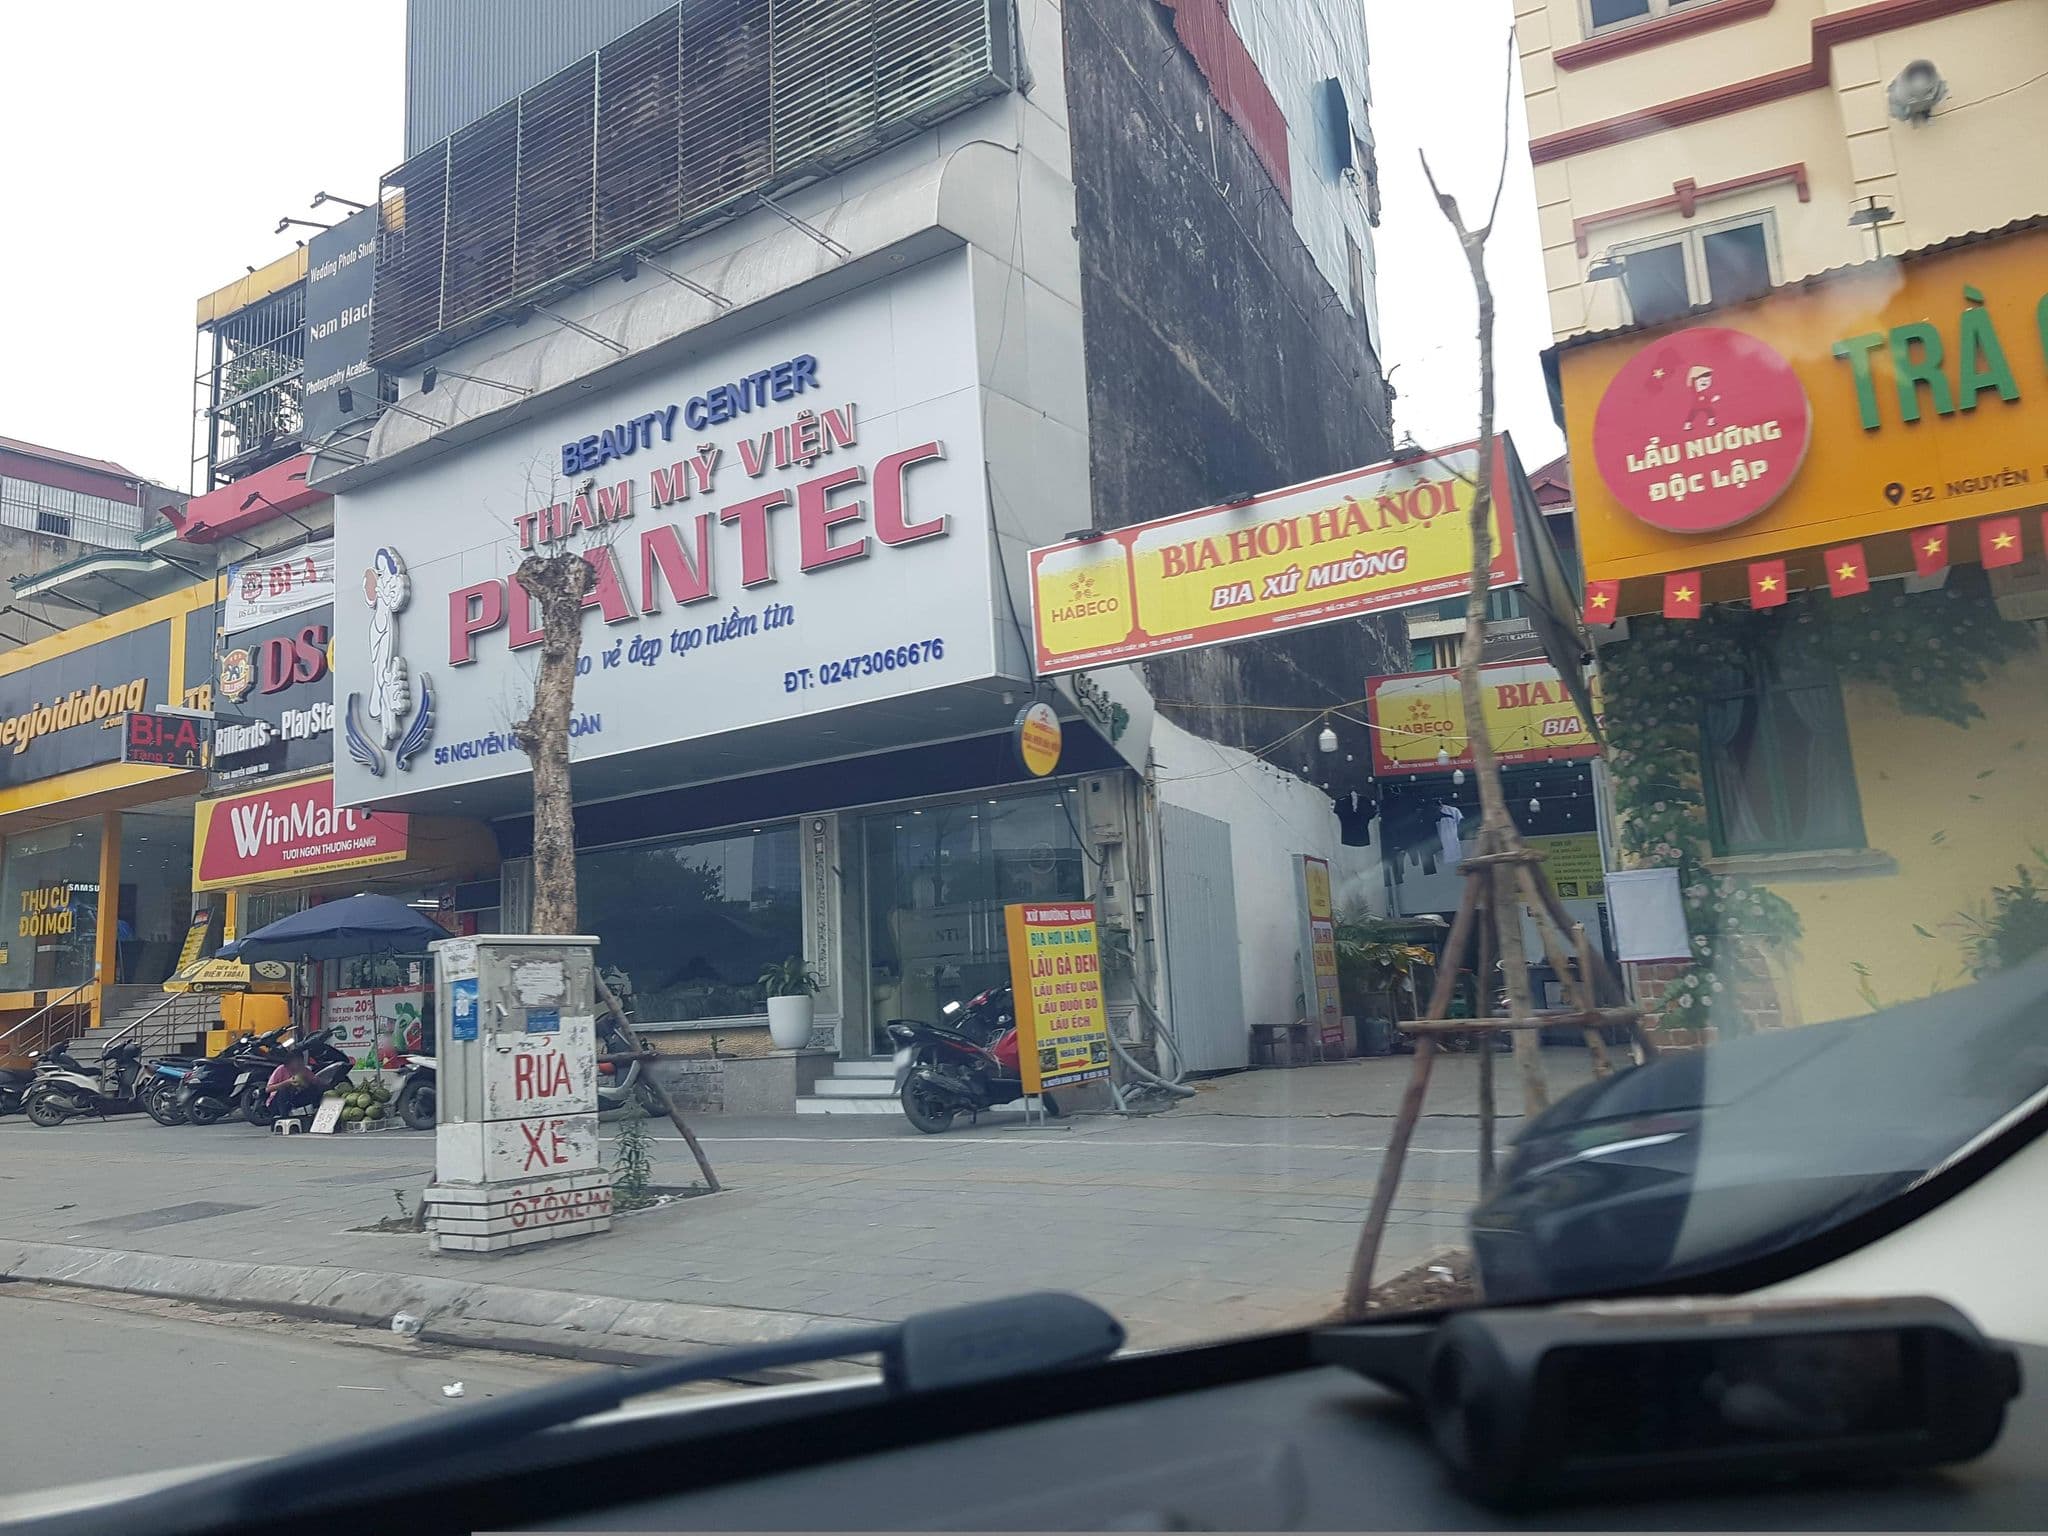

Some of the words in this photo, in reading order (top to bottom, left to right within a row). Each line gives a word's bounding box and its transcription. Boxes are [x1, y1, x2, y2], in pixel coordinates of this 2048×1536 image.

[311, 261, 337, 283] Wedding
[338, 250, 357, 271] Photo
[310, 318, 338, 343] Nam
[1832, 283, 2021, 431] TRÀ
[306, 367, 345, 396] Photography
[562, 405, 678, 477] BEAUTY
[684, 353, 821, 431] CENTER
[1626, 436, 1682, 473] LẨU
[512, 476, 634, 551] THẨM
[649, 442, 722, 510] MỸ
[736, 402, 857, 479] VIỆN
[1648, 472, 1706, 502] ĐỘC
[1710, 459, 1769, 489] LẬP
[1911, 486, 1936, 503] 52
[1945, 466, 2030, 497] NGUYỄN
[1160, 537, 1227, 580] BIA
[1227, 516, 1304, 564] HƠI
[1308, 495, 1375, 546] HÀ
[1376, 477, 1462, 529] NỘI
[448, 440, 951, 667] PLANTEC
[1210, 579, 1254, 611] BIA
[1260, 563, 1302, 599] XỨ
[1306, 546, 1408, 592] MƯỜNG
[1051, 598, 1119, 623] HABECO
[602, 638, 623, 671] vẻ
[628, 634, 663, 667] đẹp
[670, 627, 702, 657] tạo
[706, 606, 758, 645] niềm
[763, 603, 795, 632] tin
[784, 667, 815, 693] ĐT:
[819, 638, 944, 685] 02473066676
[1495, 681, 1555, 710] BIA
[130, 715, 199, 749] Bi-A
[215, 719, 271, 757] Billiards
[434, 747, 449, 765] 56
[450, 731, 504, 761] NGUYỄN
[568, 713, 602, 738] OÀN
[1390, 720, 1454, 736] HABECO
[1543, 716, 1581, 737] BIA
[167, 752, 175, 762] 2
[230, 800, 357, 859] WinMart
[300, 846, 322, 858] NGON
[21, 888, 49, 912] THU
[19, 908, 45, 937] ĐỔI
[45, 907, 73, 935] MỚI
[1030, 950, 1053, 978] LẨU
[1056, 952, 1072, 976] GÀ
[1075, 954, 1098, 974] ĐEN
[1034, 981, 1052, 997] LẨU
[1038, 998, 1057, 1014] LẨU
[1050, 1014, 1069, 1031] LẨU
[515, 1036, 573, 1101] RỬA
[521, 1120, 569, 1172] XE
